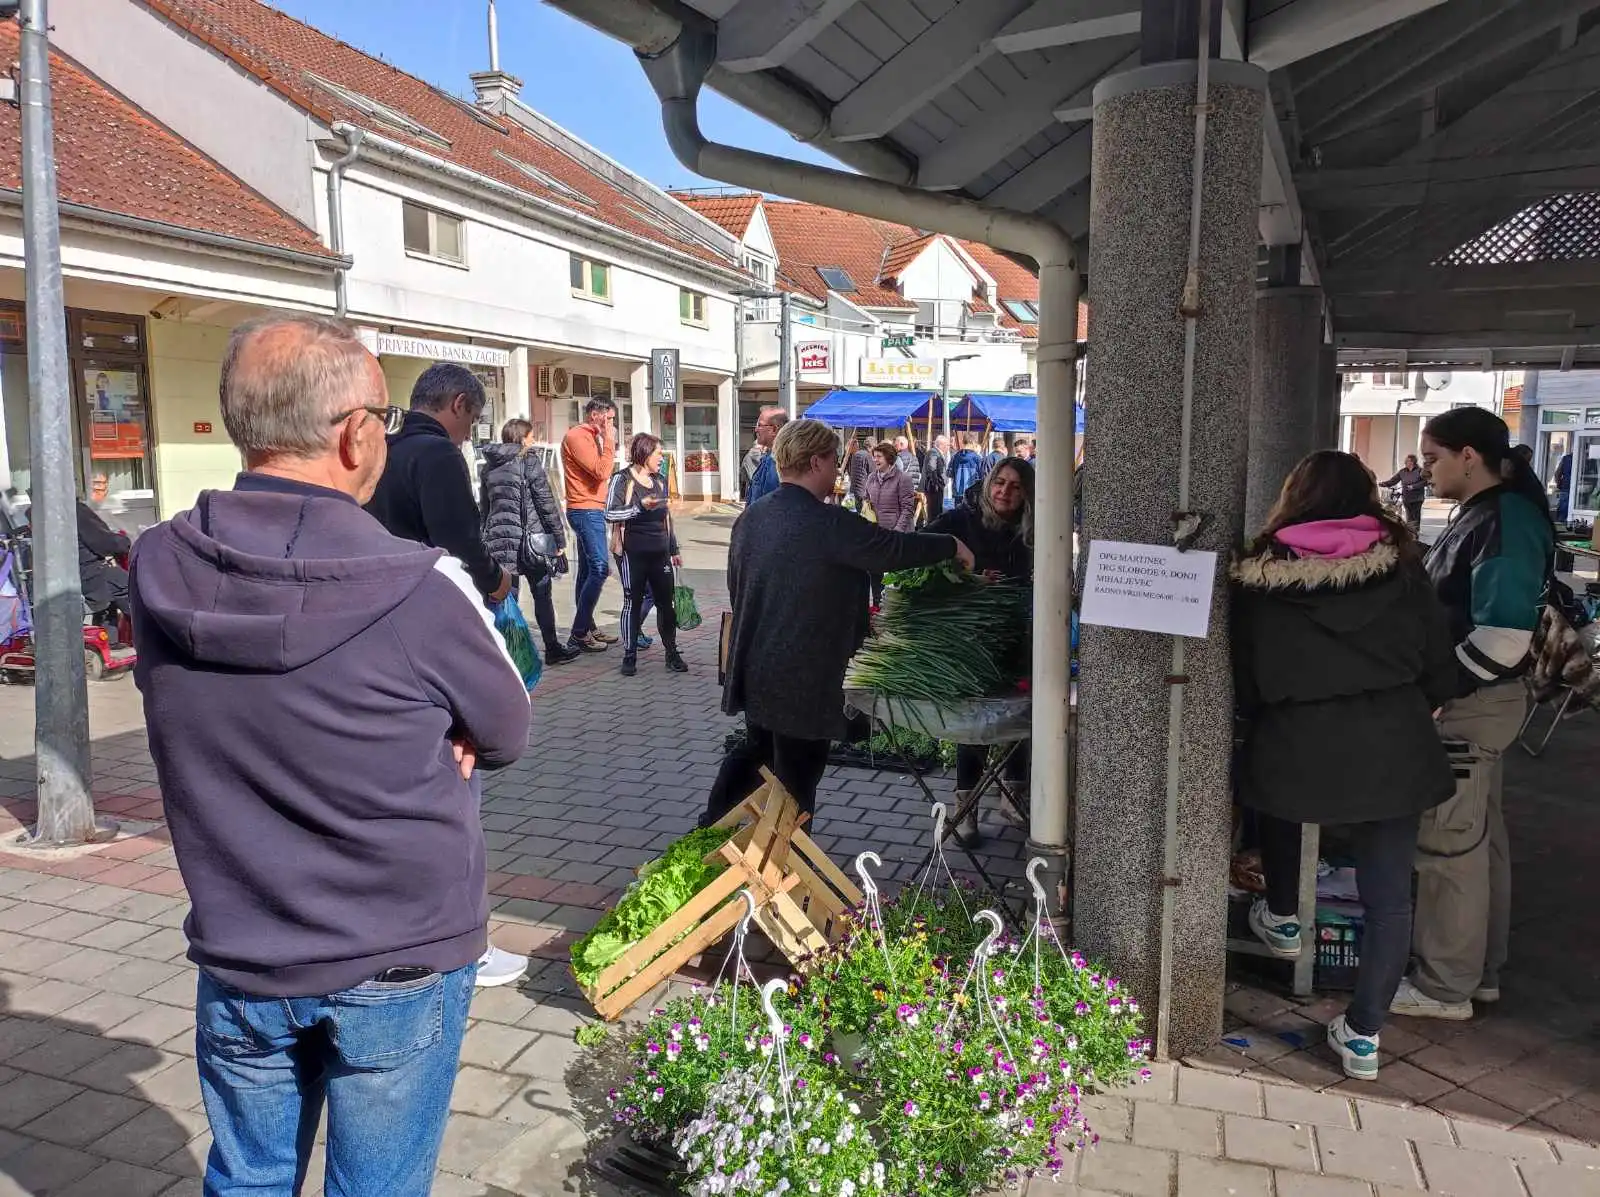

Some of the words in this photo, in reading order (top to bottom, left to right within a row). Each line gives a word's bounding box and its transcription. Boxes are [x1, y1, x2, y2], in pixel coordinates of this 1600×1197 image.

[887, 337, 910, 346] PAN
[379, 338, 439, 357] PRIVREDNA
[442, 346, 472, 361] BANKA
[804, 359, 825, 368] KIS
[867, 361, 933, 375] Lido
[663, 355, 673, 400] ANNA
[1099, 552, 1117, 561] OPG
[1119, 554, 1166, 565] MARTINEC
[1098, 563, 1116, 571] TRG
[1117, 565, 1160, 577] SLOBODE
[1170, 570, 1198, 581] DONJI
[1096, 574, 1153, 587] MIHALJEVEC
[1094, 587, 1121, 595] RADNO
